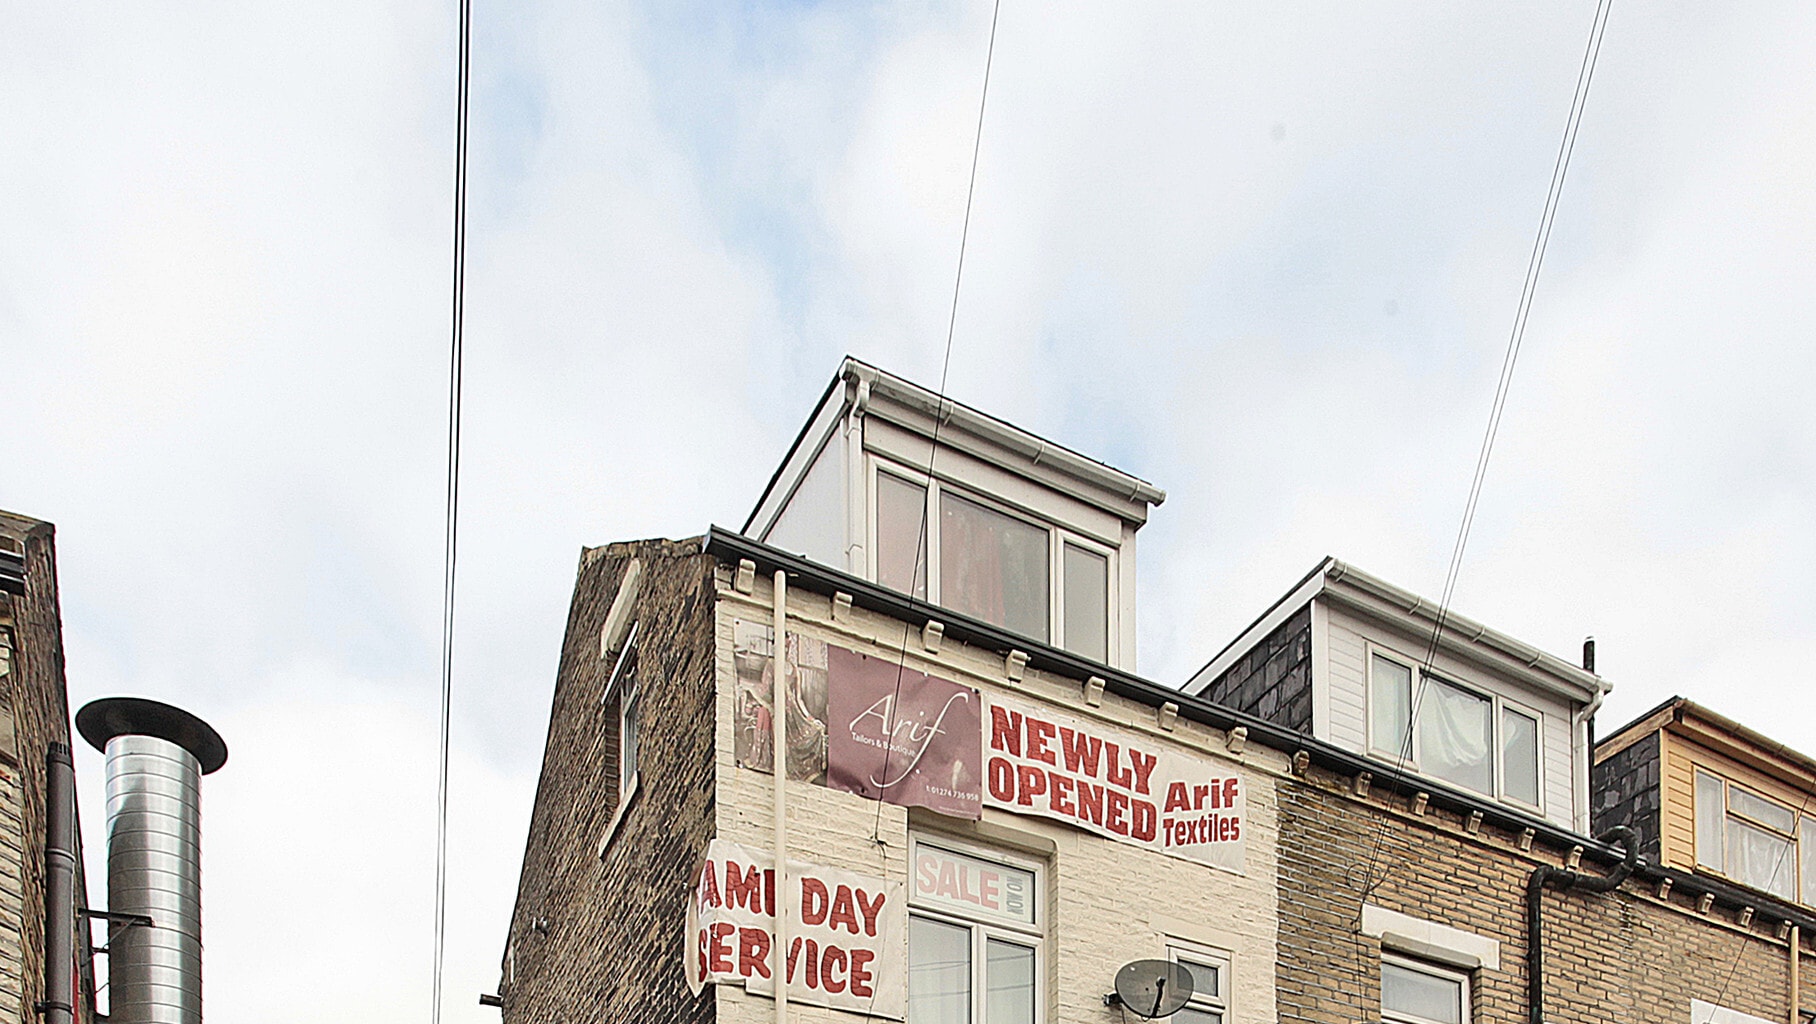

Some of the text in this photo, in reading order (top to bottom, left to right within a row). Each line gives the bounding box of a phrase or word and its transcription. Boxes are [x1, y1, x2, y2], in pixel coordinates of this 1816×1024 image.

[849, 692, 969, 788] Arif
[851, 731, 875, 746] Tailors
[990, 704, 1157, 796] NEWLY
[988, 756, 1157, 842] OPENED
[1163, 778, 1238, 813] Arif
[1163, 813, 1240, 847] Textiles
[801, 876, 885, 937] DAY
[917, 854, 1000, 910] SALE
